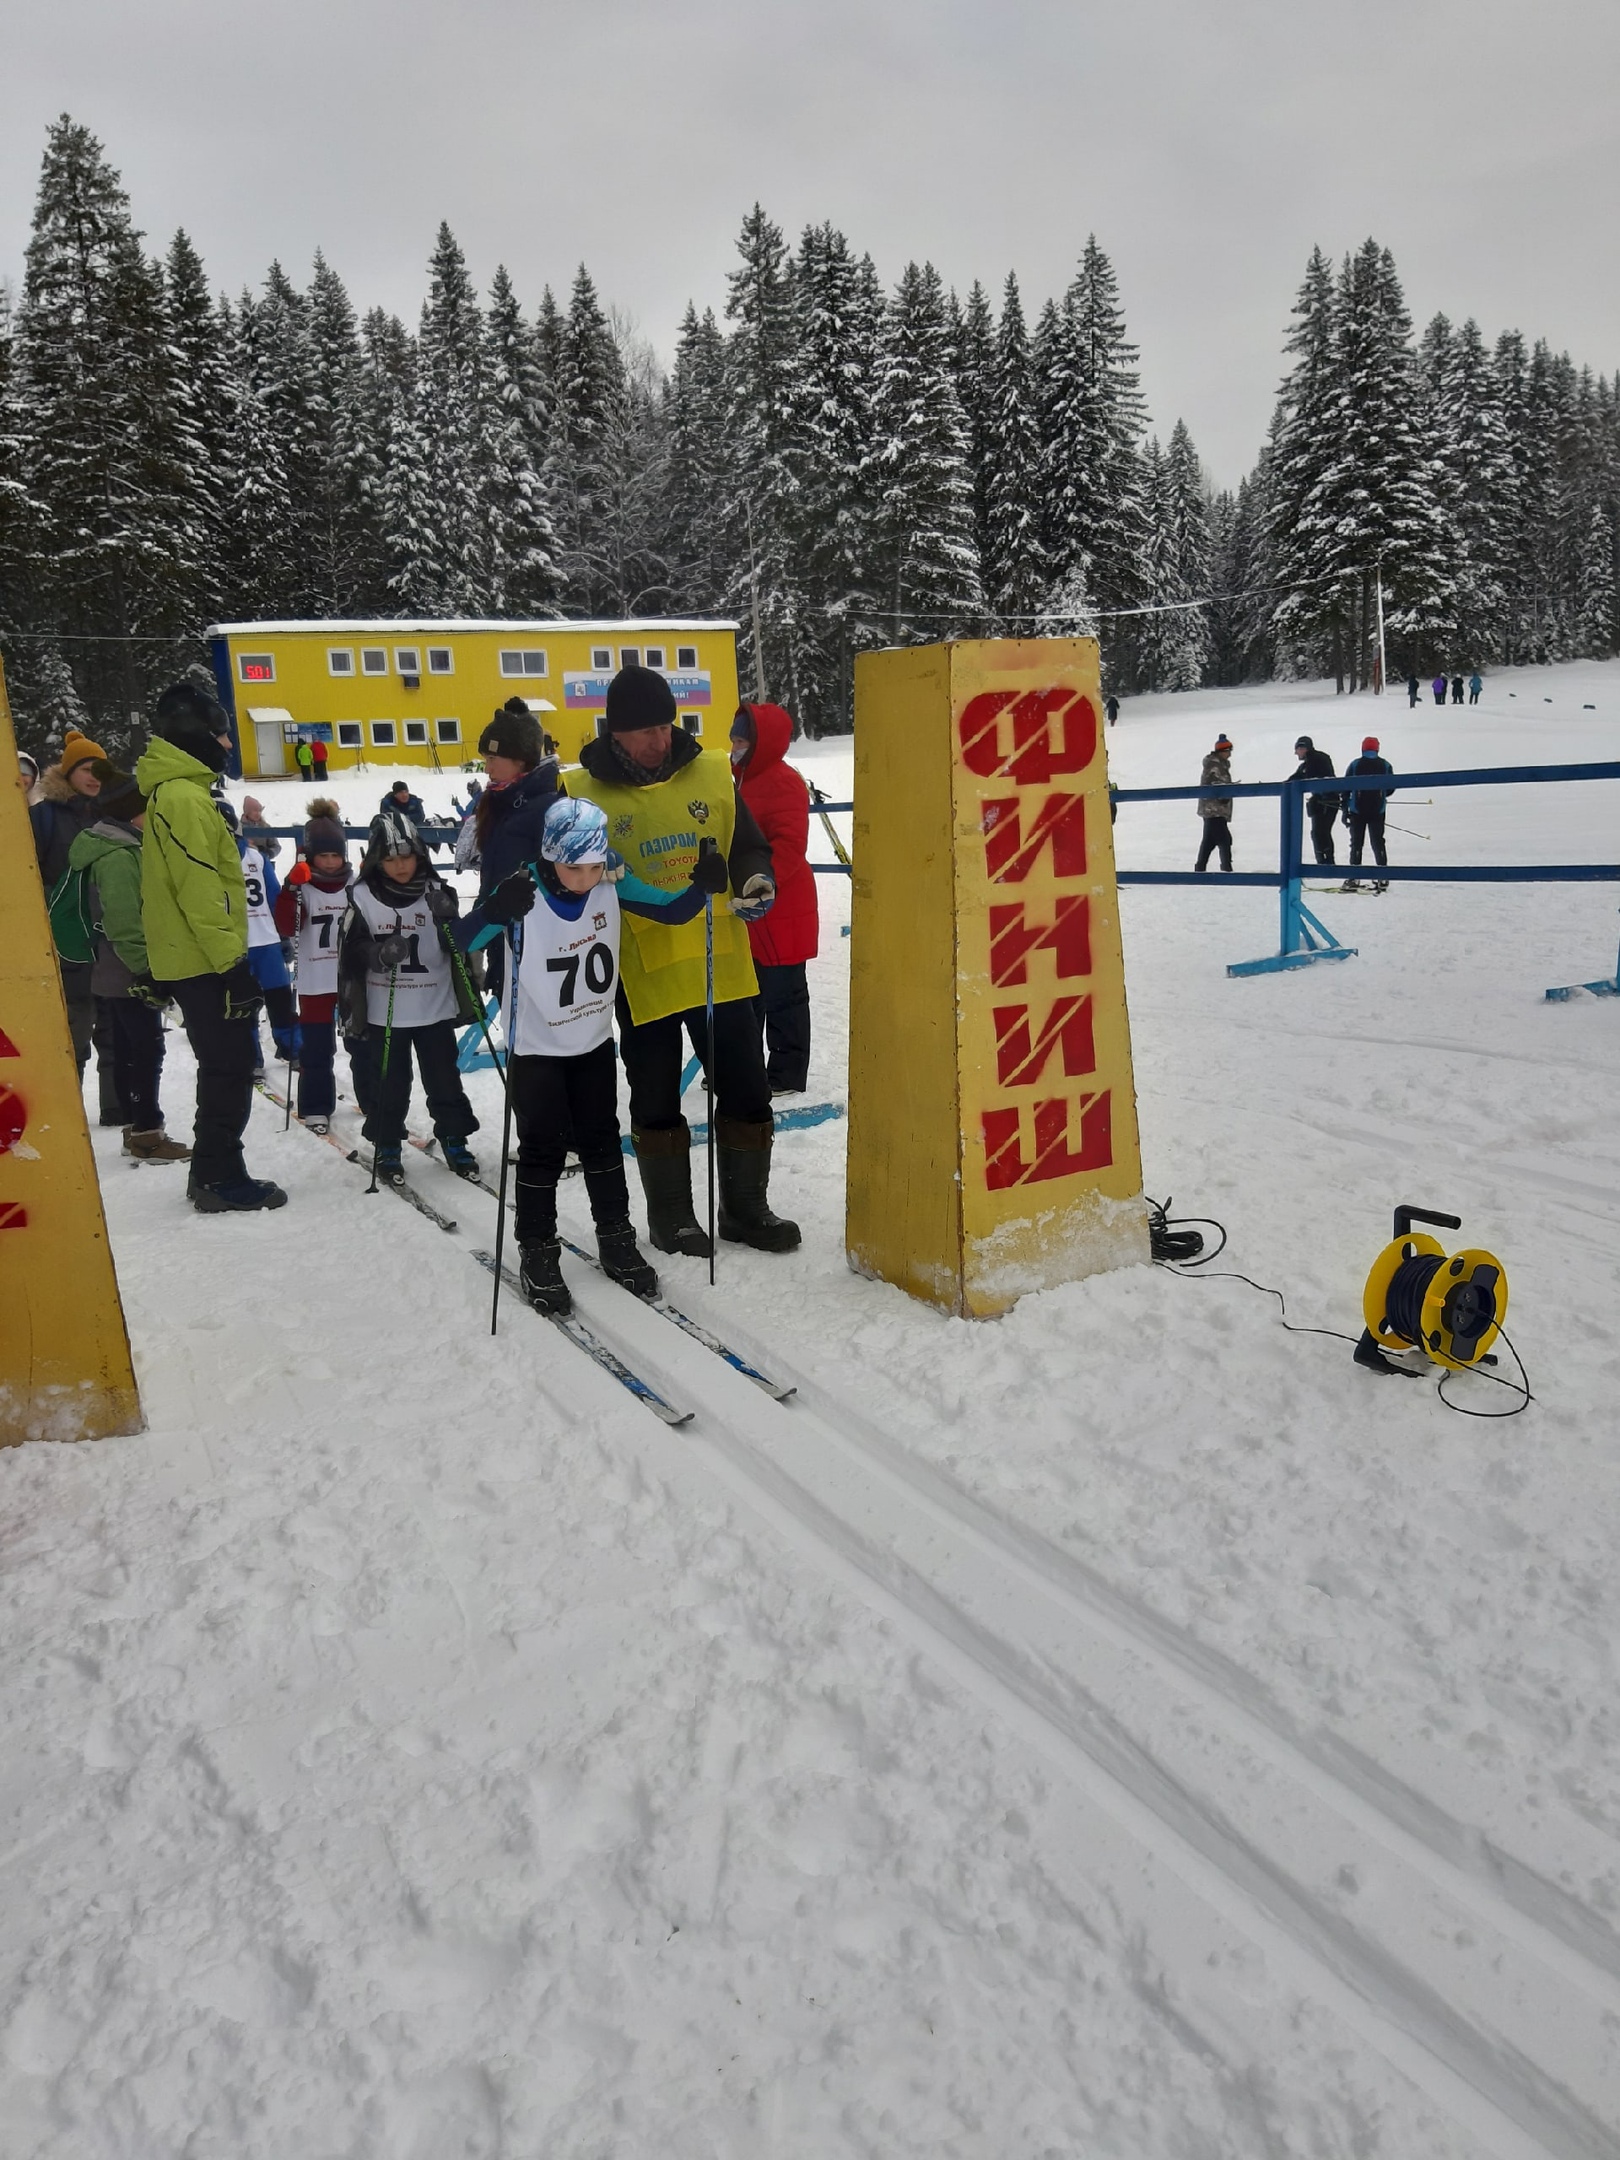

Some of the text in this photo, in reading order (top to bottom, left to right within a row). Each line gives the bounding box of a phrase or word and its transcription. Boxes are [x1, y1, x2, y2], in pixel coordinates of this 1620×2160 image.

[639, 832, 697, 858] ГАЗПРОМ
[662, 855, 698, 868] TOYOTA
[245, 878, 264, 907] 3
[653, 872, 687, 887] ЛЫЖНЯ
[311, 914, 342, 949] 7
[568, 933, 597, 952] Лысьва
[958, 688, 1113, 1192] ФИНИШ
[546, 942, 615, 1008] 70
